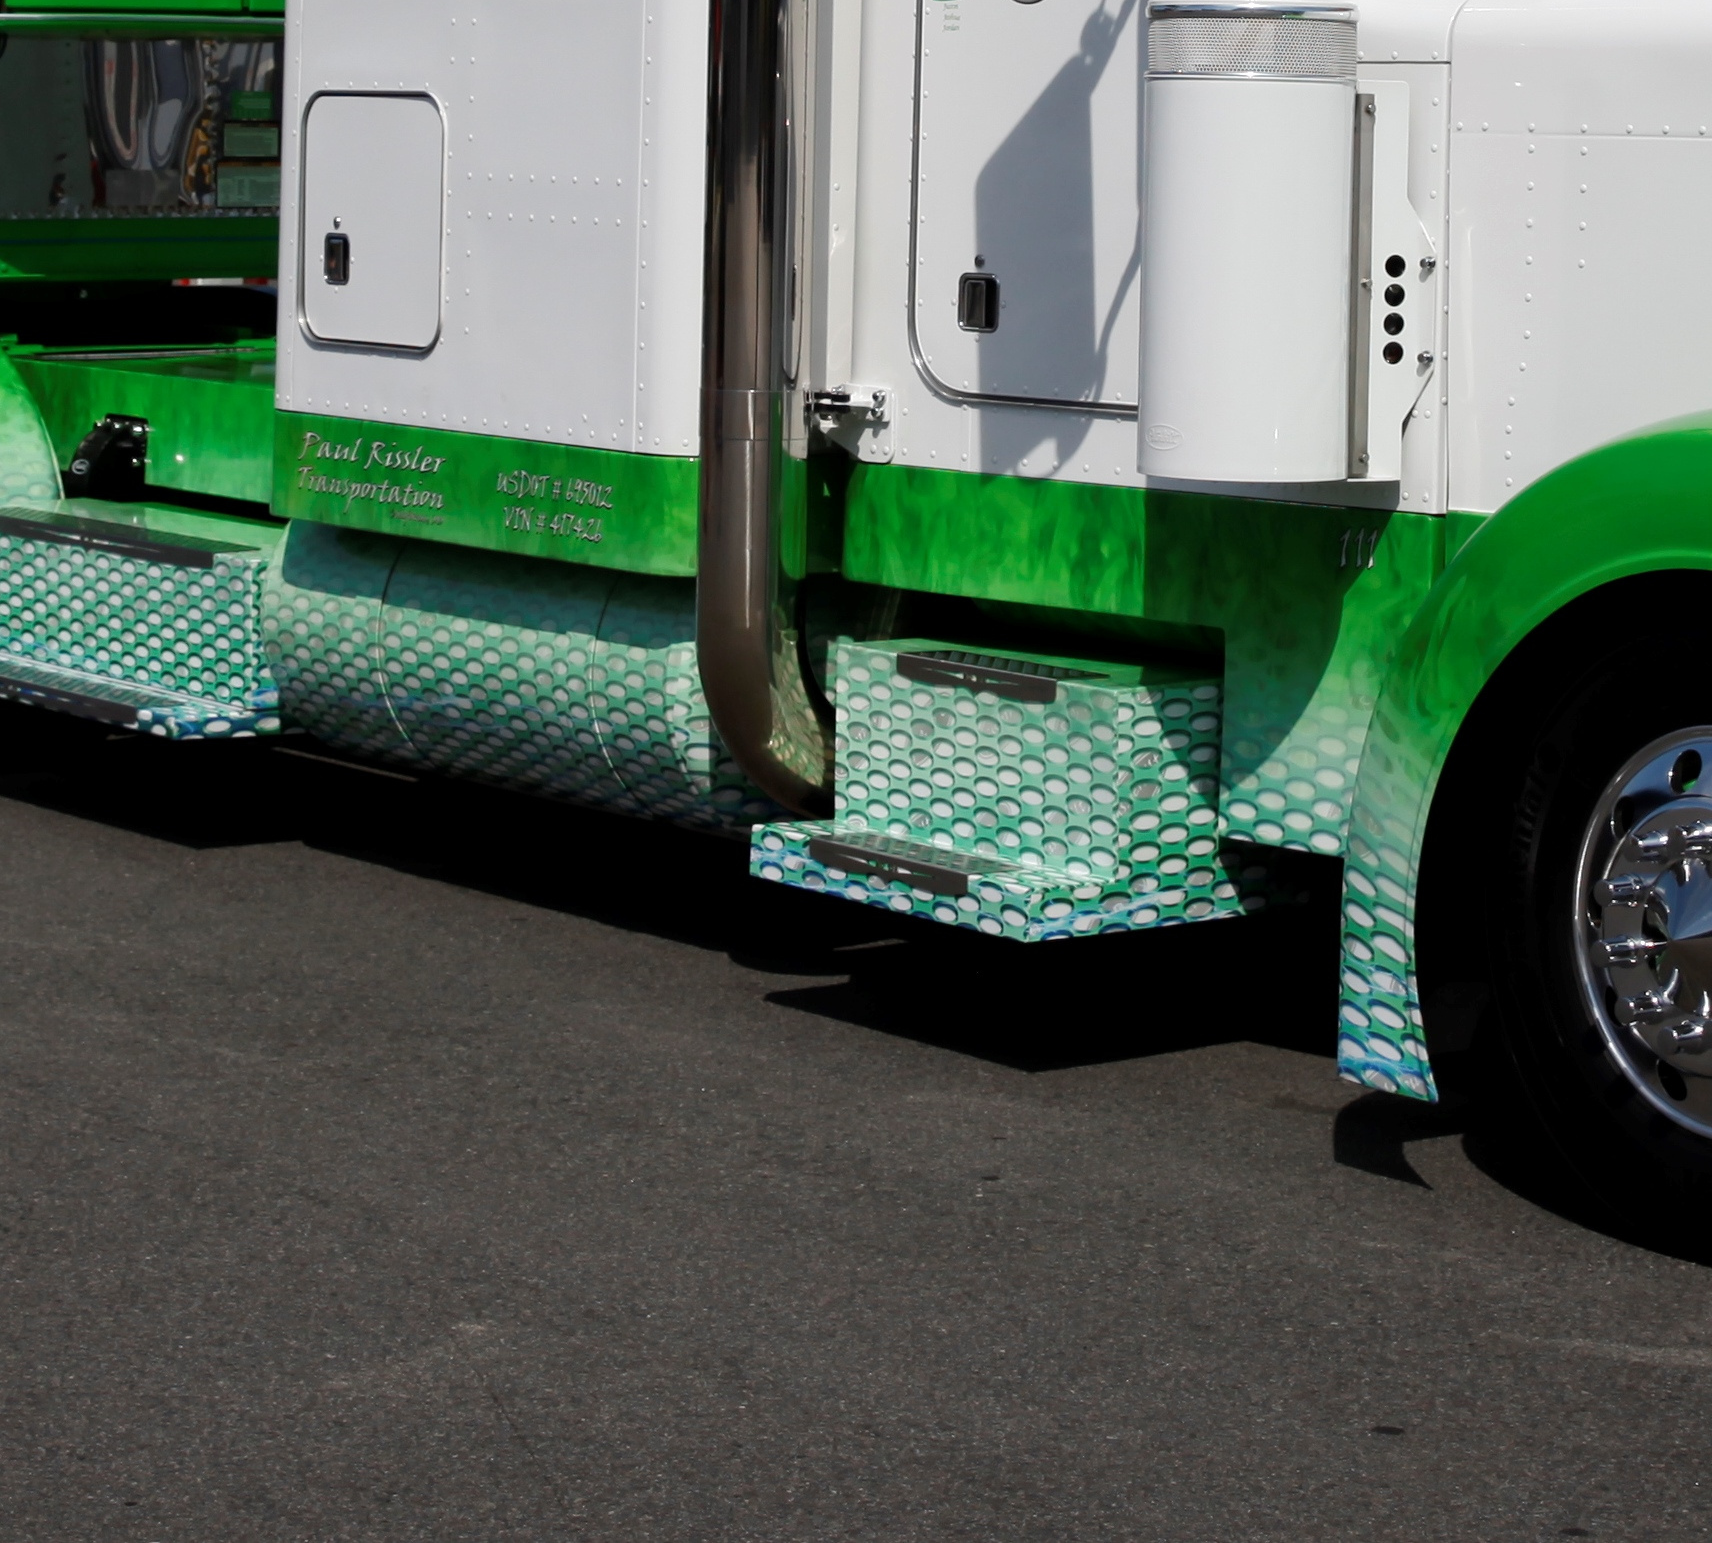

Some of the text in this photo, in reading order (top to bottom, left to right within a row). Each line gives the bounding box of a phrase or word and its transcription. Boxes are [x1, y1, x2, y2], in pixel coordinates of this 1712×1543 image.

[297, 431, 447, 473] Paul Rissler
[297, 466, 445, 515] Transportation
[496, 469, 551, 499] USDOT
[503, 506, 535, 533] VIN
